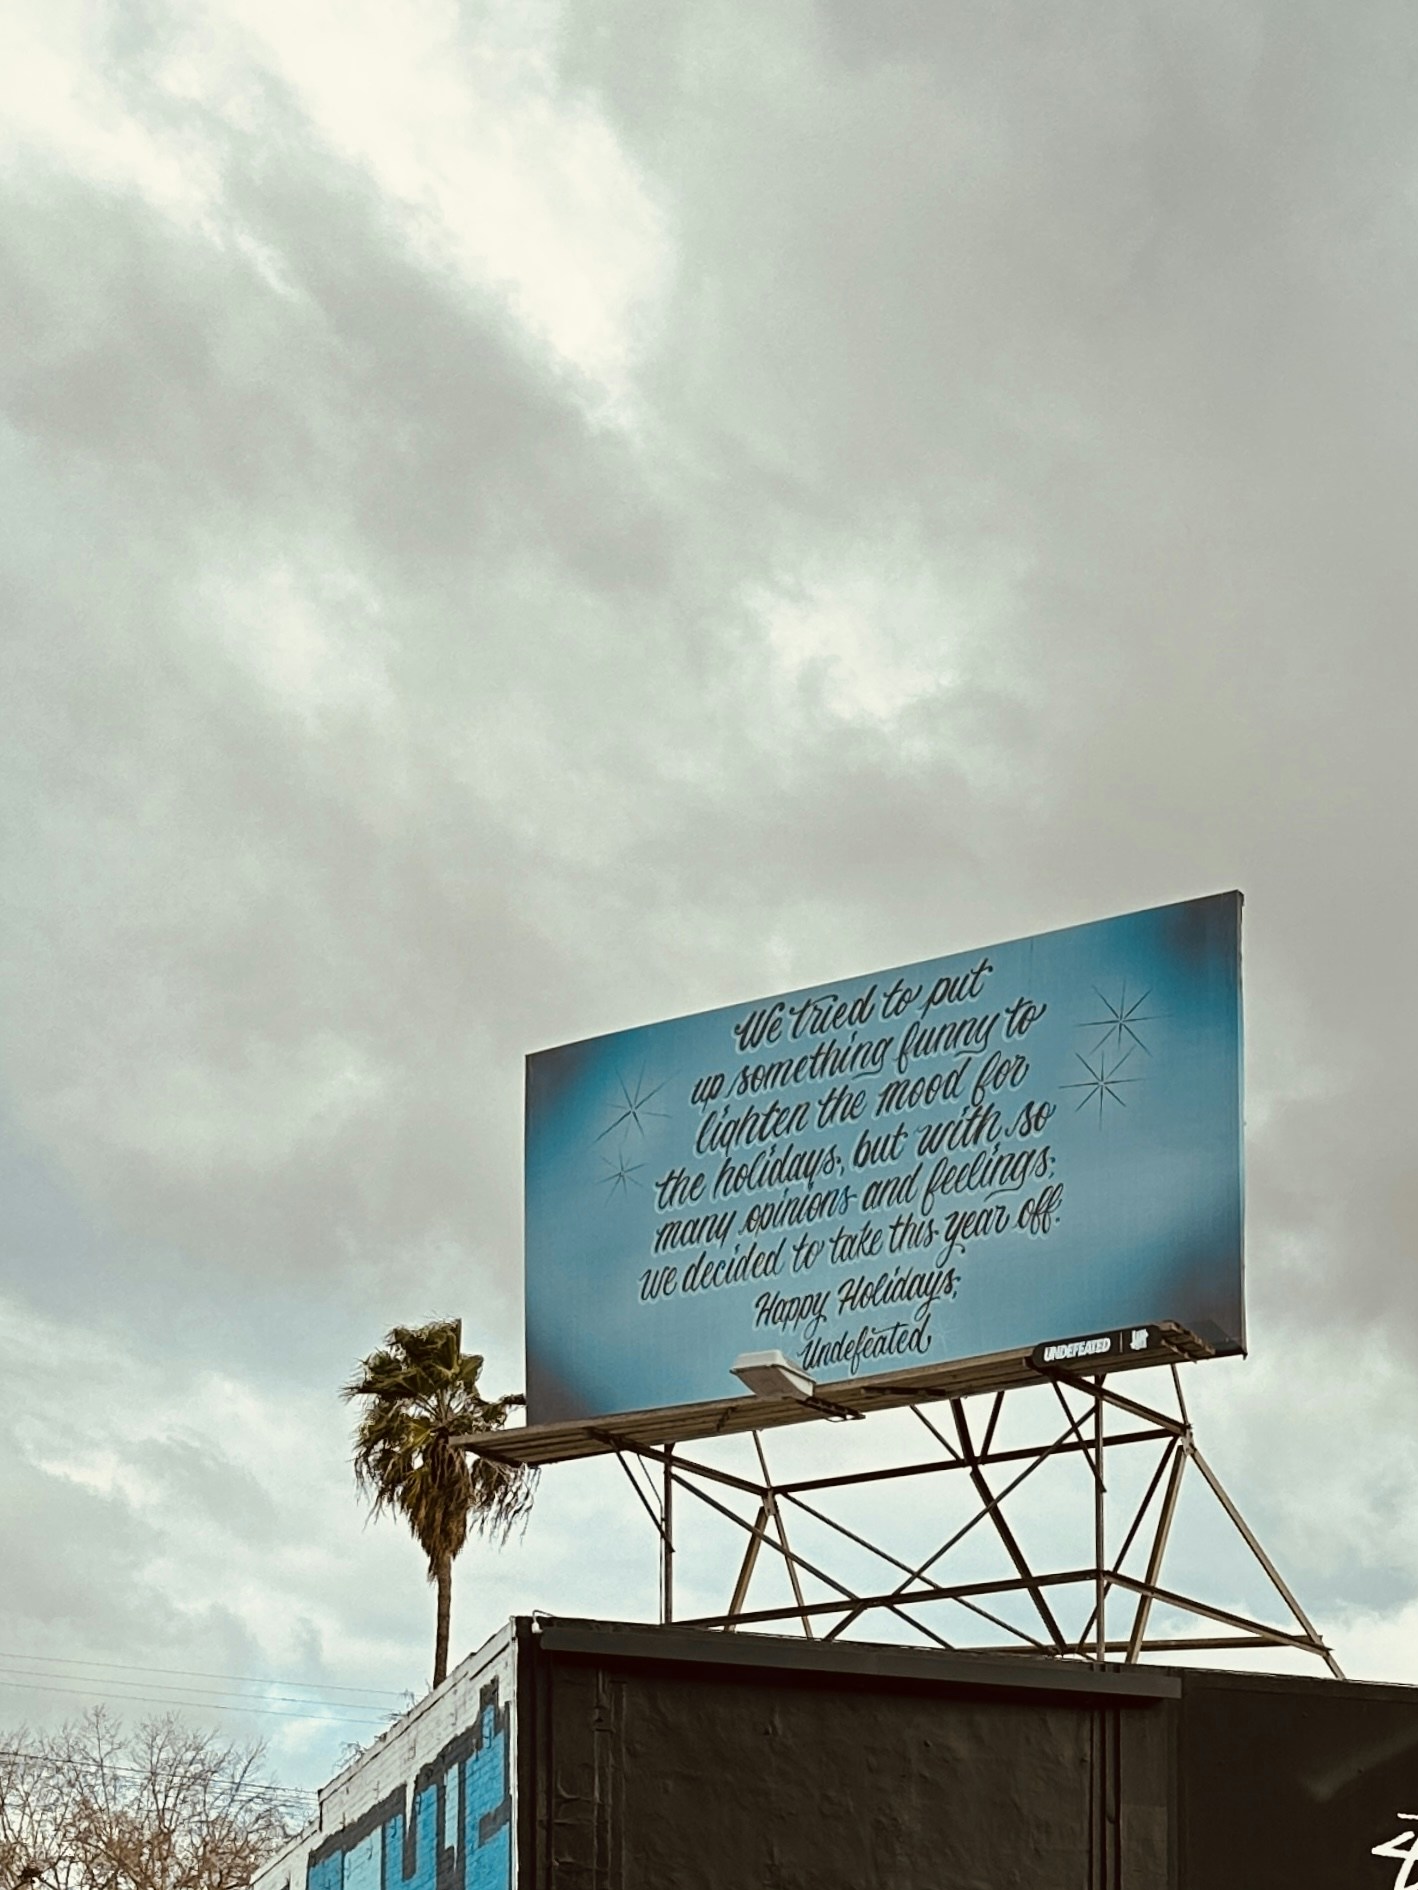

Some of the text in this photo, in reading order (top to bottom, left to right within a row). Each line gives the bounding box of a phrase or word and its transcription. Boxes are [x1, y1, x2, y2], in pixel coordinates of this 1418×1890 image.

[734, 958, 994, 1051] We tried to put
[690, 996, 1047, 1113] up something funny to
[695, 1050, 1030, 1158] lighten the mood for
[655, 1166, 707, 1210] the
[852, 1121, 909, 1168] but
[913, 1102, 1002, 1157] with
[1004, 1100, 1057, 1138] so
[639, 1265, 679, 1301] we
[681, 1237, 788, 1293] decided
[792, 1231, 825, 1273] to
[829, 1220, 884, 1265] take
[888, 1212, 940, 1254] this
[934, 1204, 1011, 1269] year
[654, 1209, 738, 1254] many
[738, 1181, 858, 1238] opinions
[861, 1161, 924, 1212] and
[754, 1289, 832, 1336] Happy
[796, 1312, 933, 1376] Undefeated
[1043, 1337, 1111, 1362] UNDEFEATED
